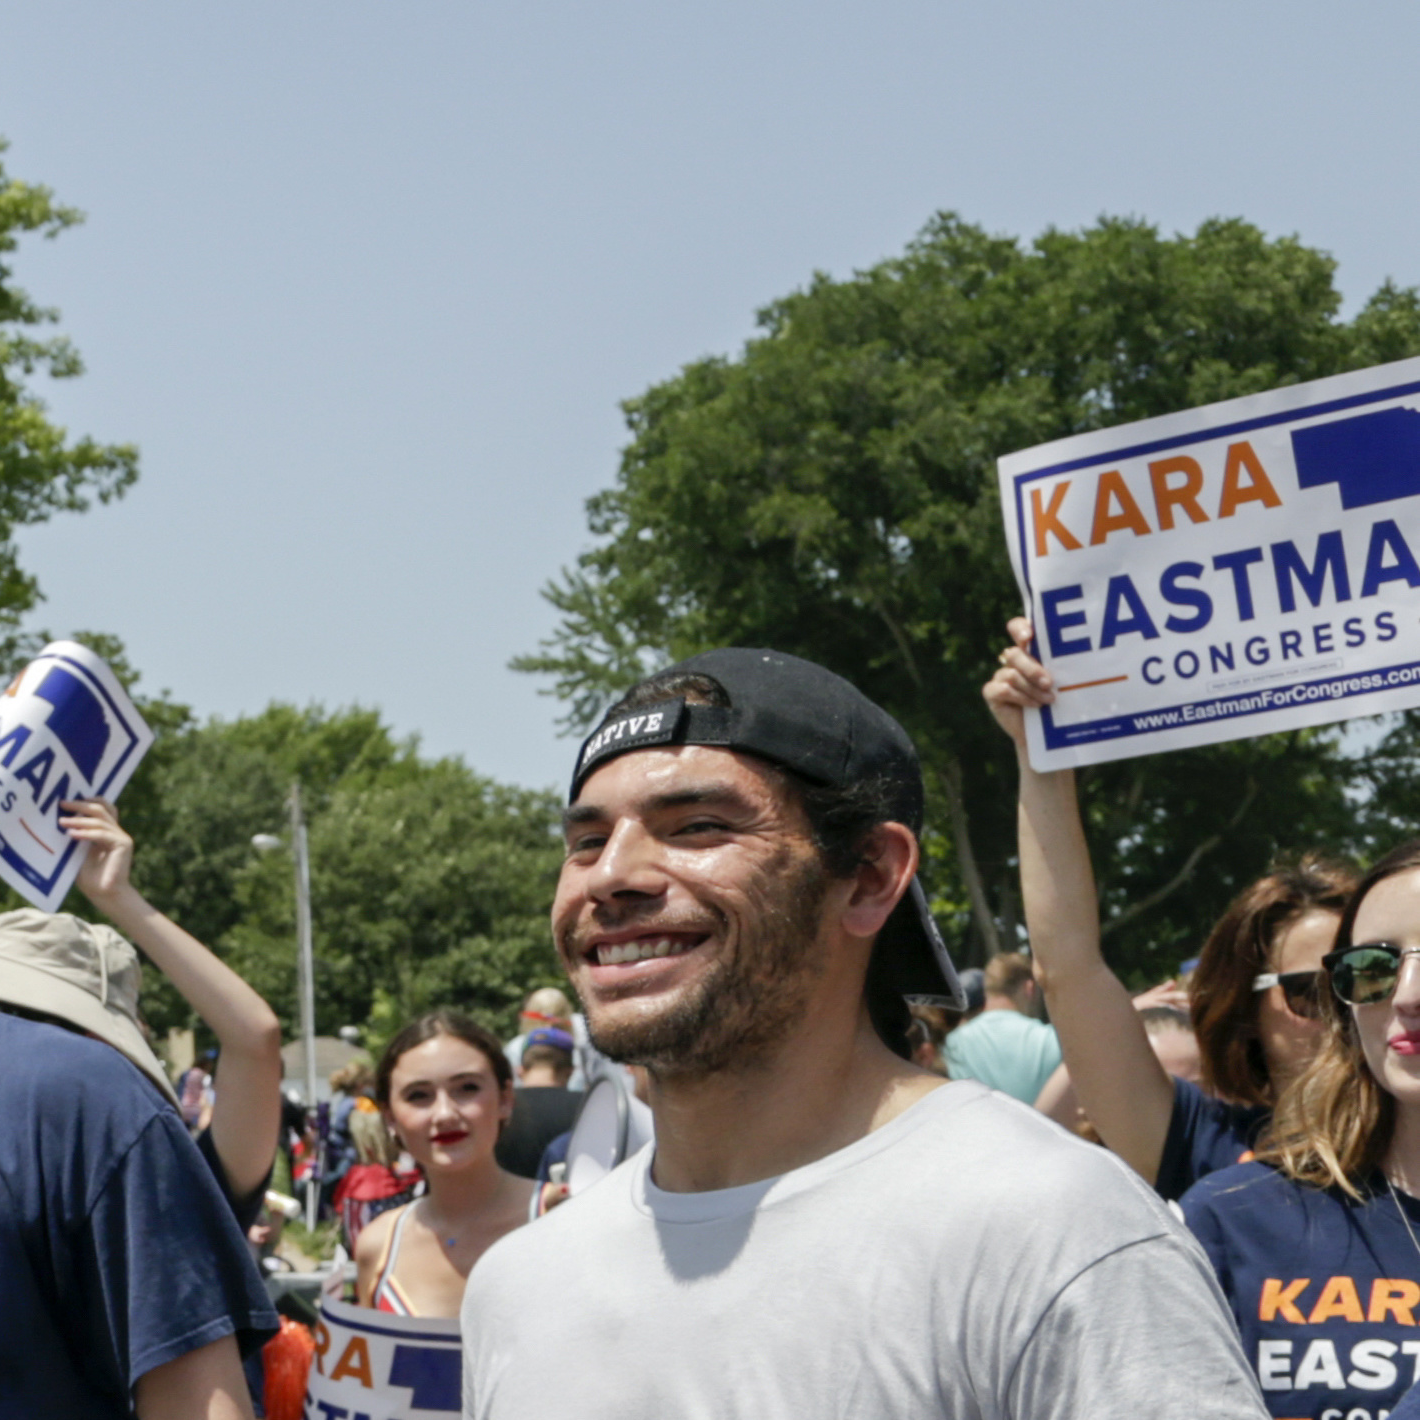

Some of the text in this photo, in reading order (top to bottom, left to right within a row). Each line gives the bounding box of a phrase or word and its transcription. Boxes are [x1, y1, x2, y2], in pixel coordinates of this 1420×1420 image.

[1030, 440, 1282, 557] KARA
[1141, 611, 1398, 685] CONGRESS
[582, 711, 664, 764] NATIVE
